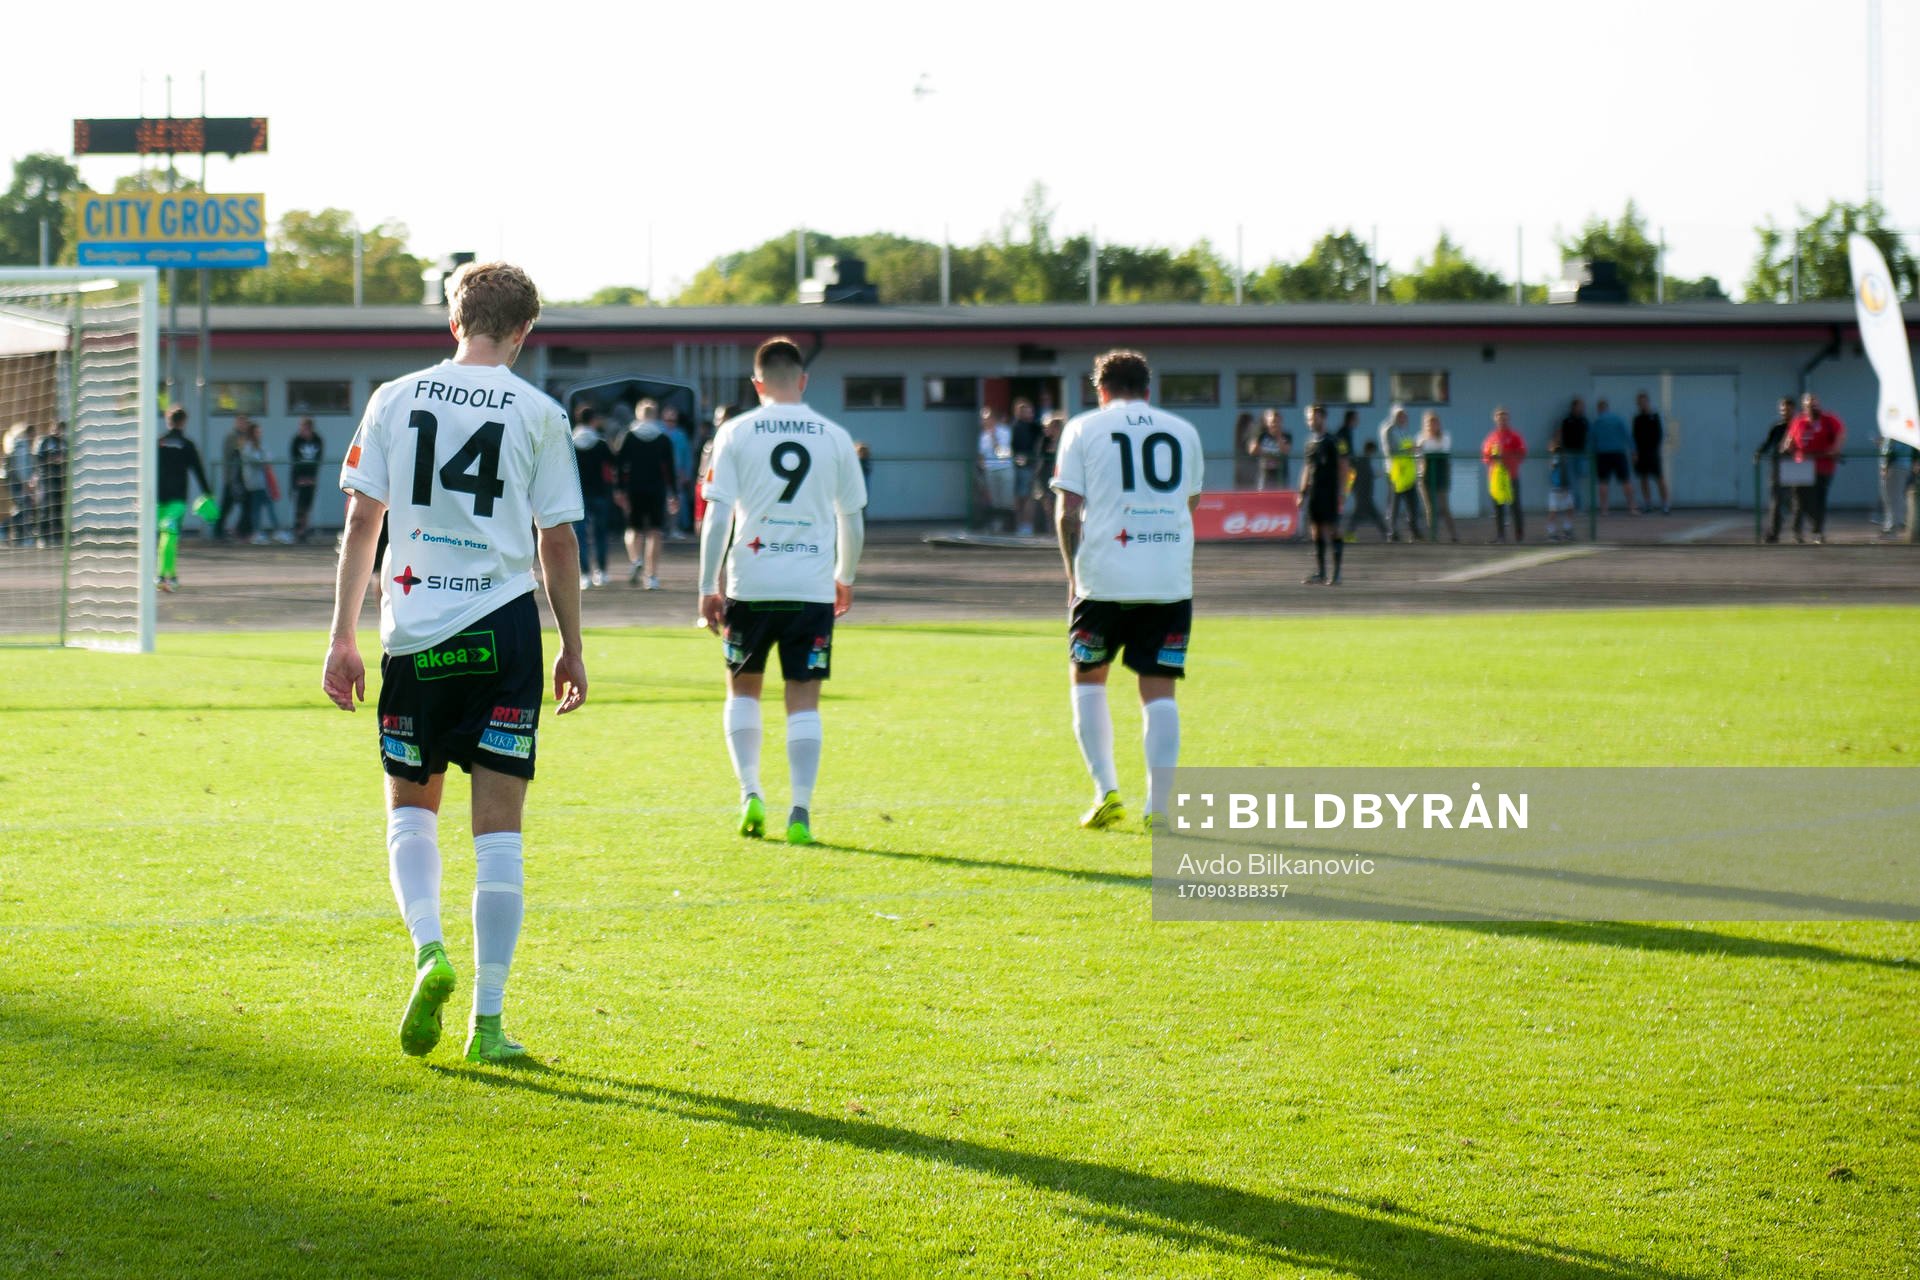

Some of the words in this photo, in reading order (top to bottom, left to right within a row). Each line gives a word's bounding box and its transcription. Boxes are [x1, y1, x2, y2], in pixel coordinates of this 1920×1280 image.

[85, 200, 151, 236] CITY
[160, 199, 260, 236] GROSS
[414, 380, 516, 410] FRIDOLF
[754, 420, 825, 435] HUMMET
[1126, 415, 1154, 426] LAI
[408, 409, 505, 518] 14
[770, 441, 812, 504] 9
[1111, 432, 1183, 493] 10
[422, 533, 462, 546] Domino's
[464, 539, 488, 550] Pizza
[417, 648, 468, 668] akea
